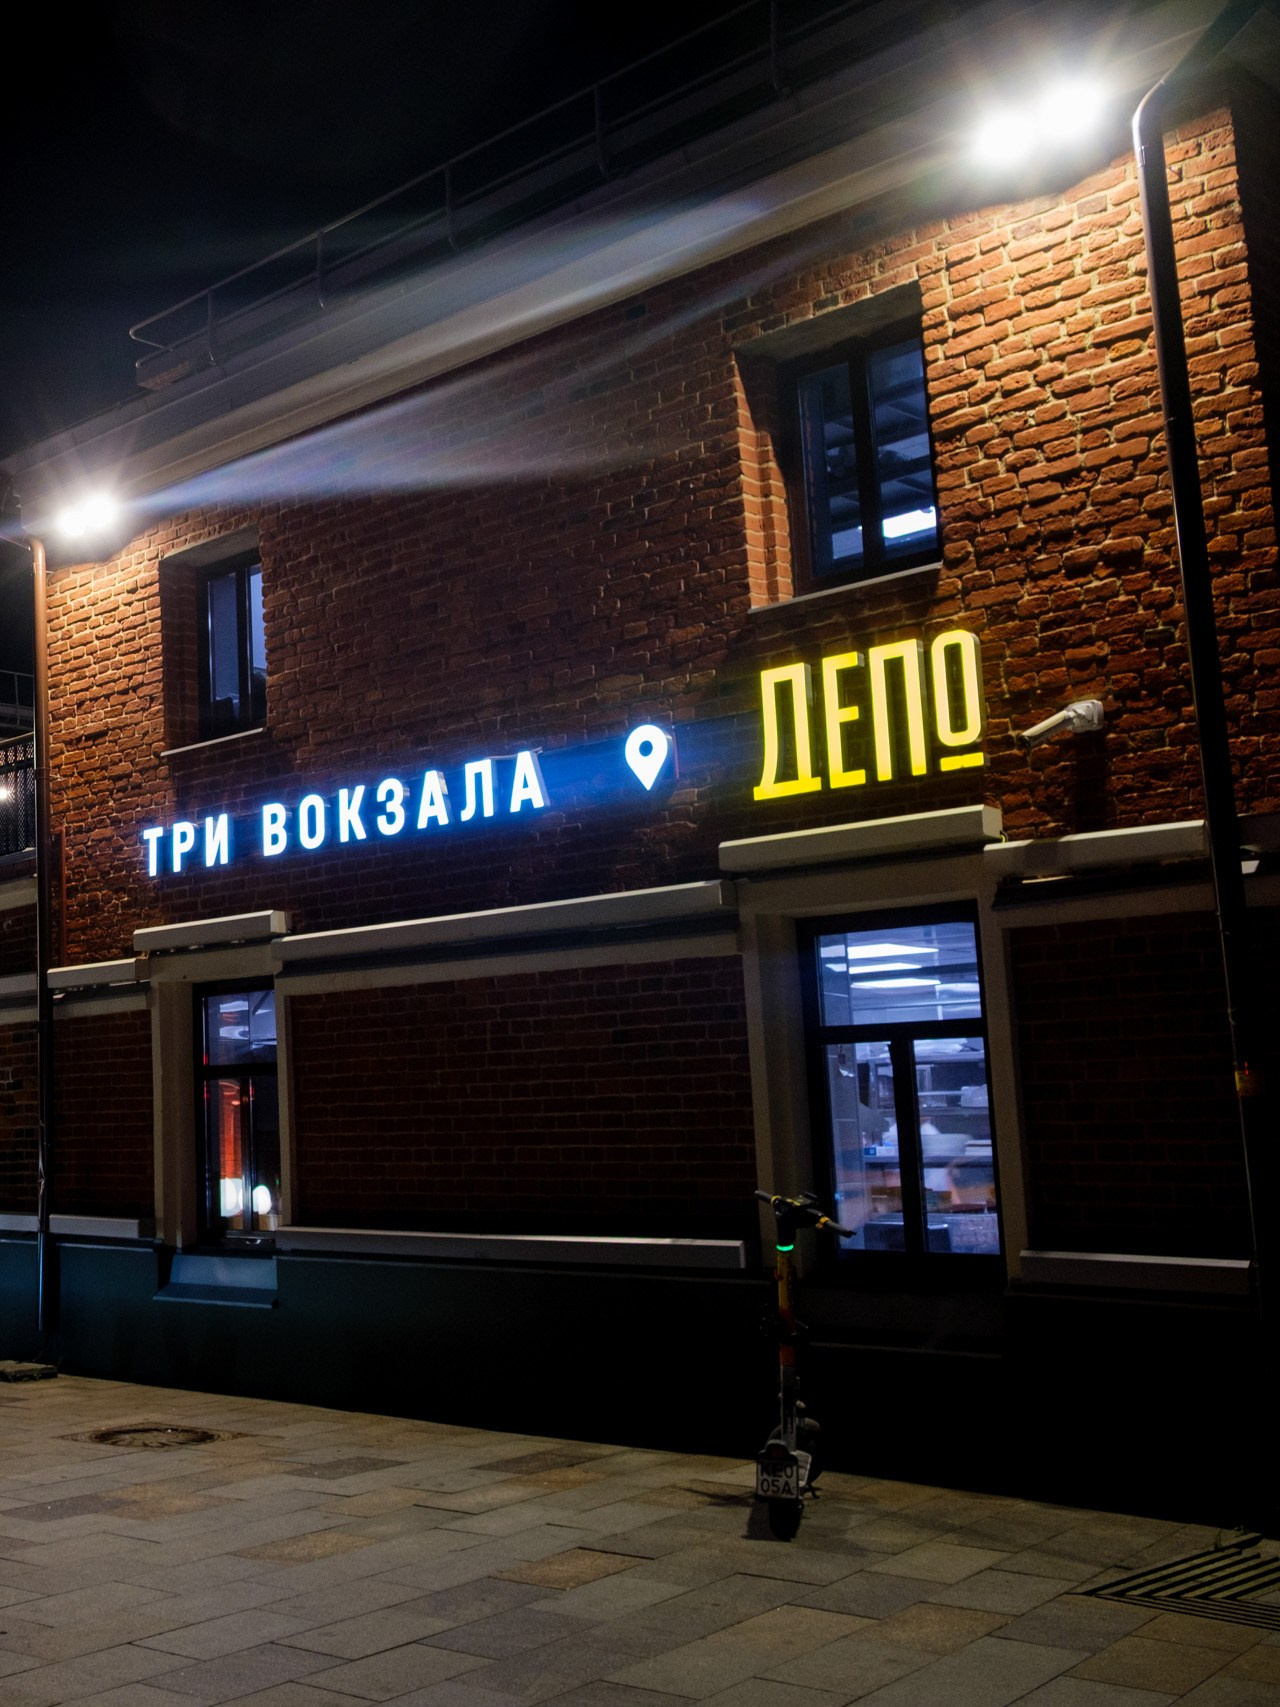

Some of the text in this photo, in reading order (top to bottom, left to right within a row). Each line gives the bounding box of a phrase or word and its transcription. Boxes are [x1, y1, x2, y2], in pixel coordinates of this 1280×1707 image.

[753, 629, 985, 801] ДЕПО
[143, 750, 546, 877] ТРИ ВОКЗАЛА
